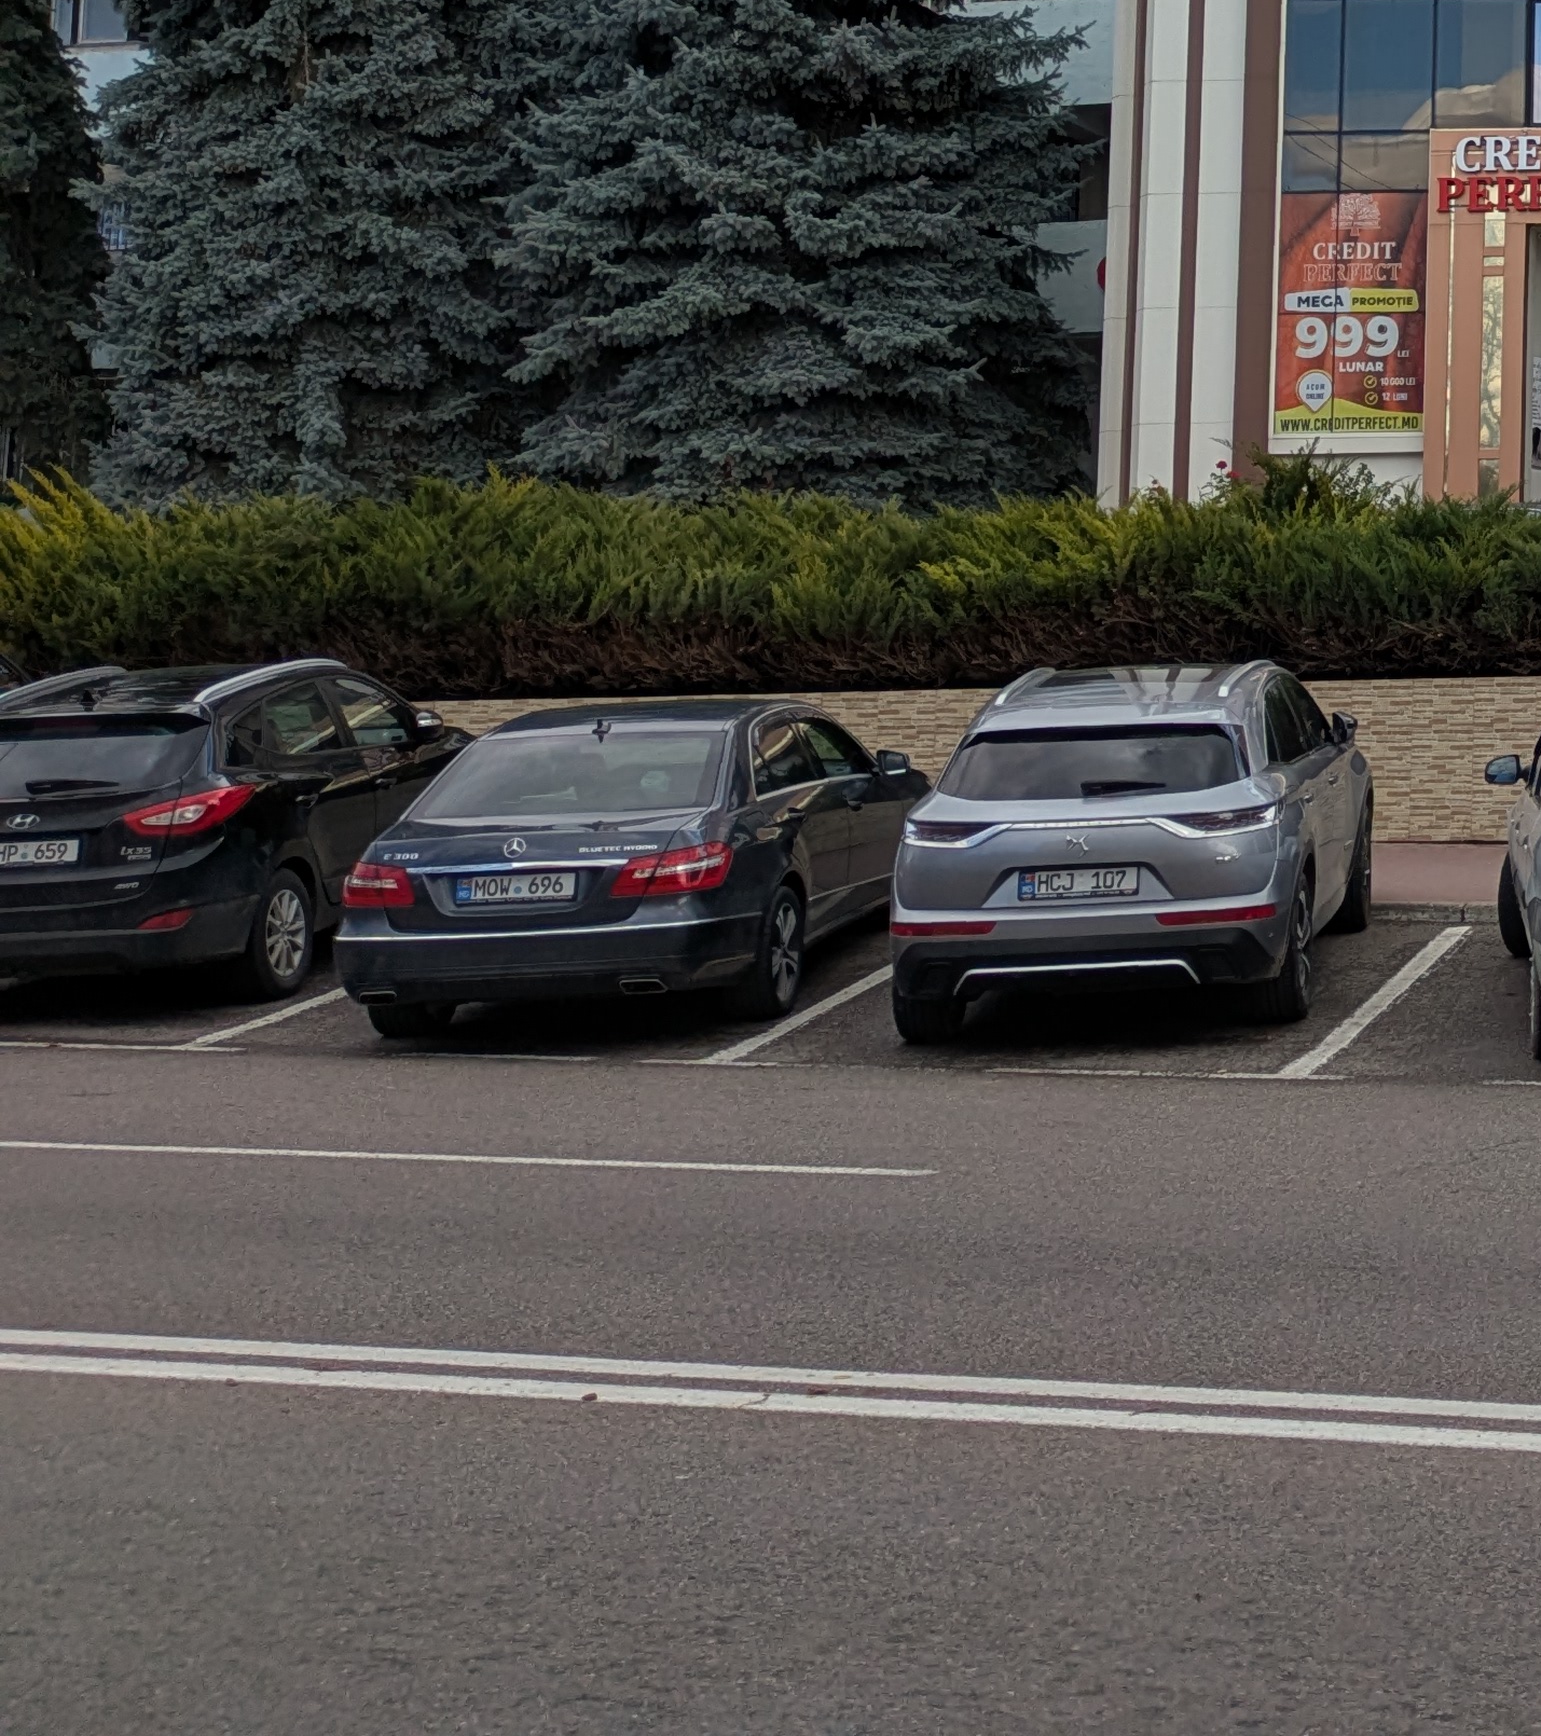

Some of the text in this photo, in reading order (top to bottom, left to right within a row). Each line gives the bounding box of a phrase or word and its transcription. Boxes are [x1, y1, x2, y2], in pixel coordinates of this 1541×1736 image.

[1312, 241, 1396, 260] CREDIT
[1303, 262, 1402, 283] PERFECT
[1297, 295, 1413, 309] MEGA PROMOȚIE
[1295, 315, 1399, 359] 999
[1339, 361, 1384, 373] LUNAR
[34, 843, 68, 860] 659
[474, 875, 564, 898] MOW 696
[1037, 870, 1126, 892] HCJ 107
